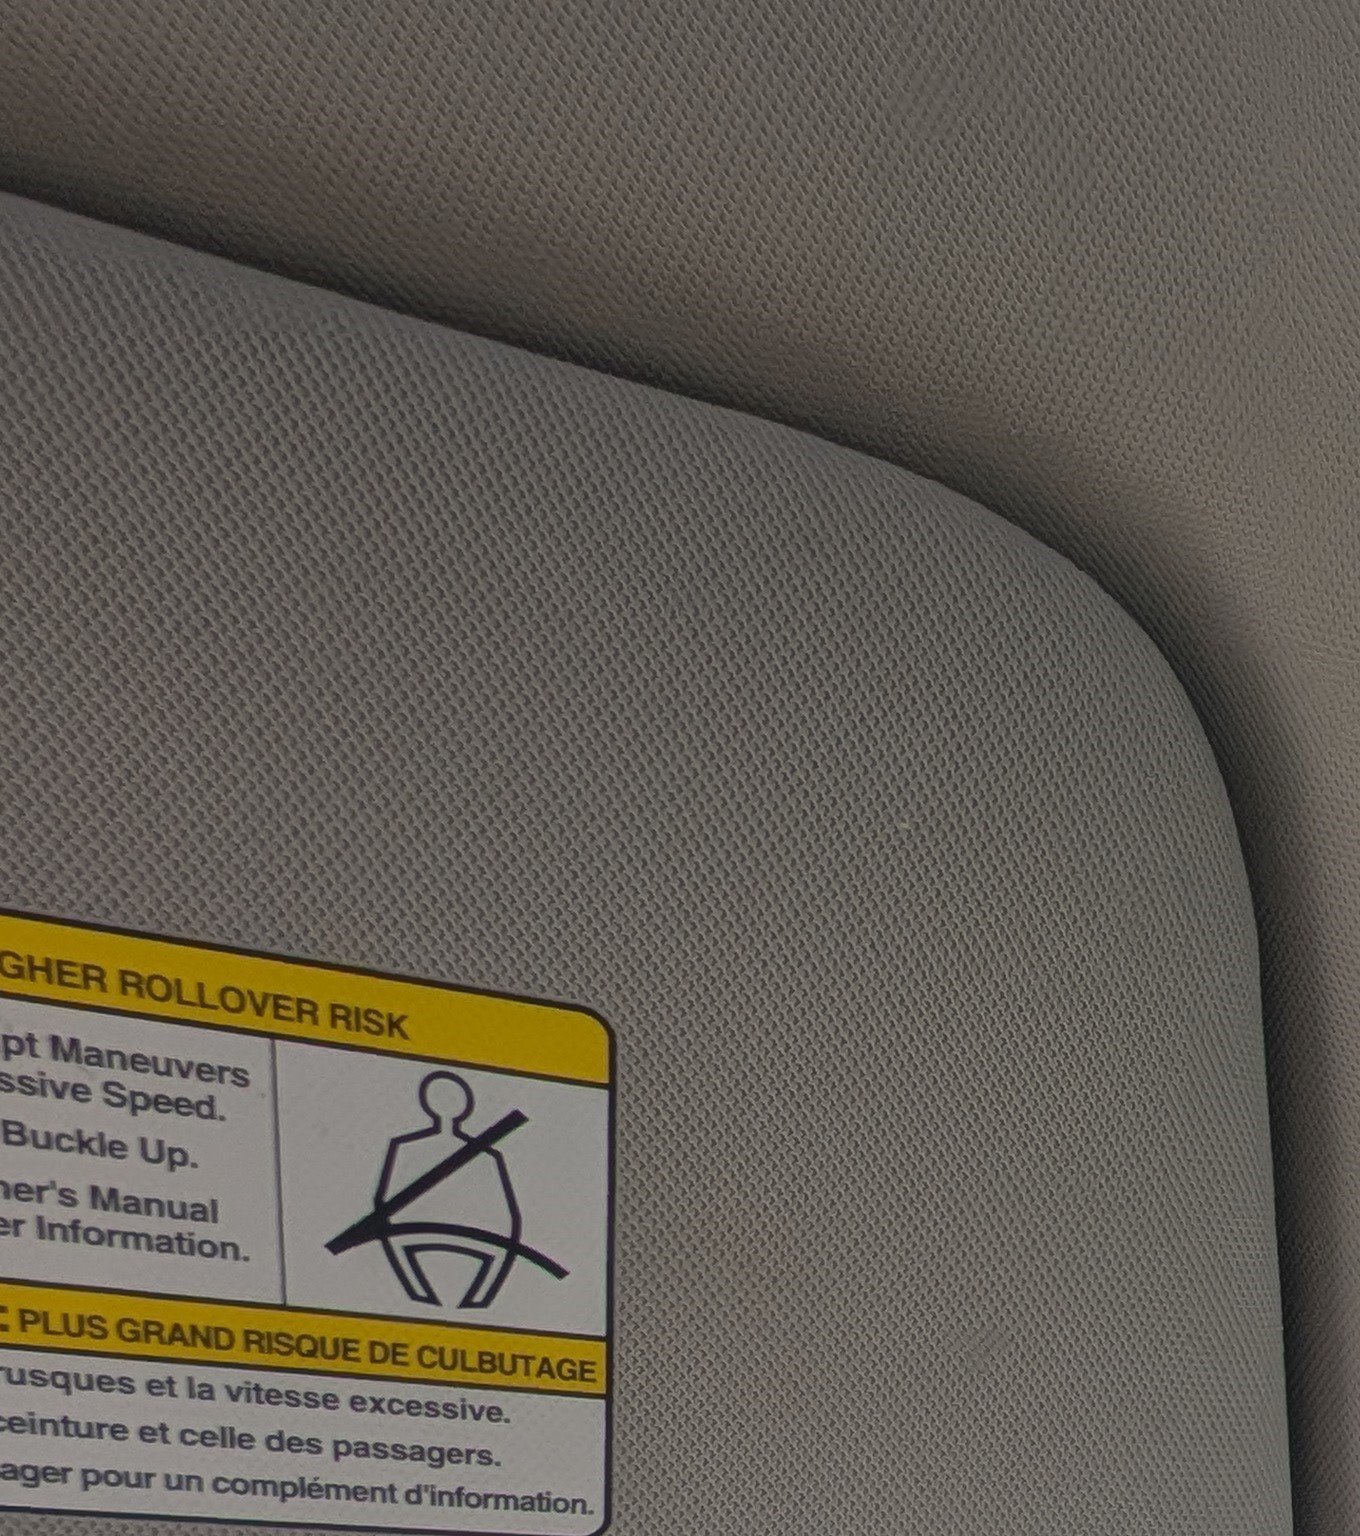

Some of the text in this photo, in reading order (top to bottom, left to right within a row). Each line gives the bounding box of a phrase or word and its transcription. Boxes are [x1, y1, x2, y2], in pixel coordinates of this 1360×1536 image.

[0, 946, 410, 1040] GHER ROLLOVER RISK
[0, 1024, 250, 1088] pt Maneuvers
[102, 1080, 226, 1122] Speed.
[0, 1117, 198, 1173] Buckle Up.
[89, 1184, 218, 1224] Manual
[35, 1215, 250, 1262] Information.
[17, 1308, 109, 1340] PLUS
[115, 1317, 236, 1351] GRAND
[243, 1329, 362, 1363] RISQUE
[368, 1340, 410, 1367] DE
[416, 1345, 597, 1384] CULBUTAGE
[145, 1375, 178, 1398] et
[186, 1376, 216, 1401] la
[224, 1381, 340, 1411] vitesse
[349, 1395, 511, 1424] excessive.
[137, 1422, 171, 1445] et
[178, 1426, 256, 1450] celle
[264, 1430, 323, 1455] des
[332, 1439, 501, 1469] passagers.
[80, 1468, 157, 1492] pour
[164, 1473, 204, 1493] un
[211, 1476, 399, 1504] complément
[404, 1484, 594, 1515] d'information.
